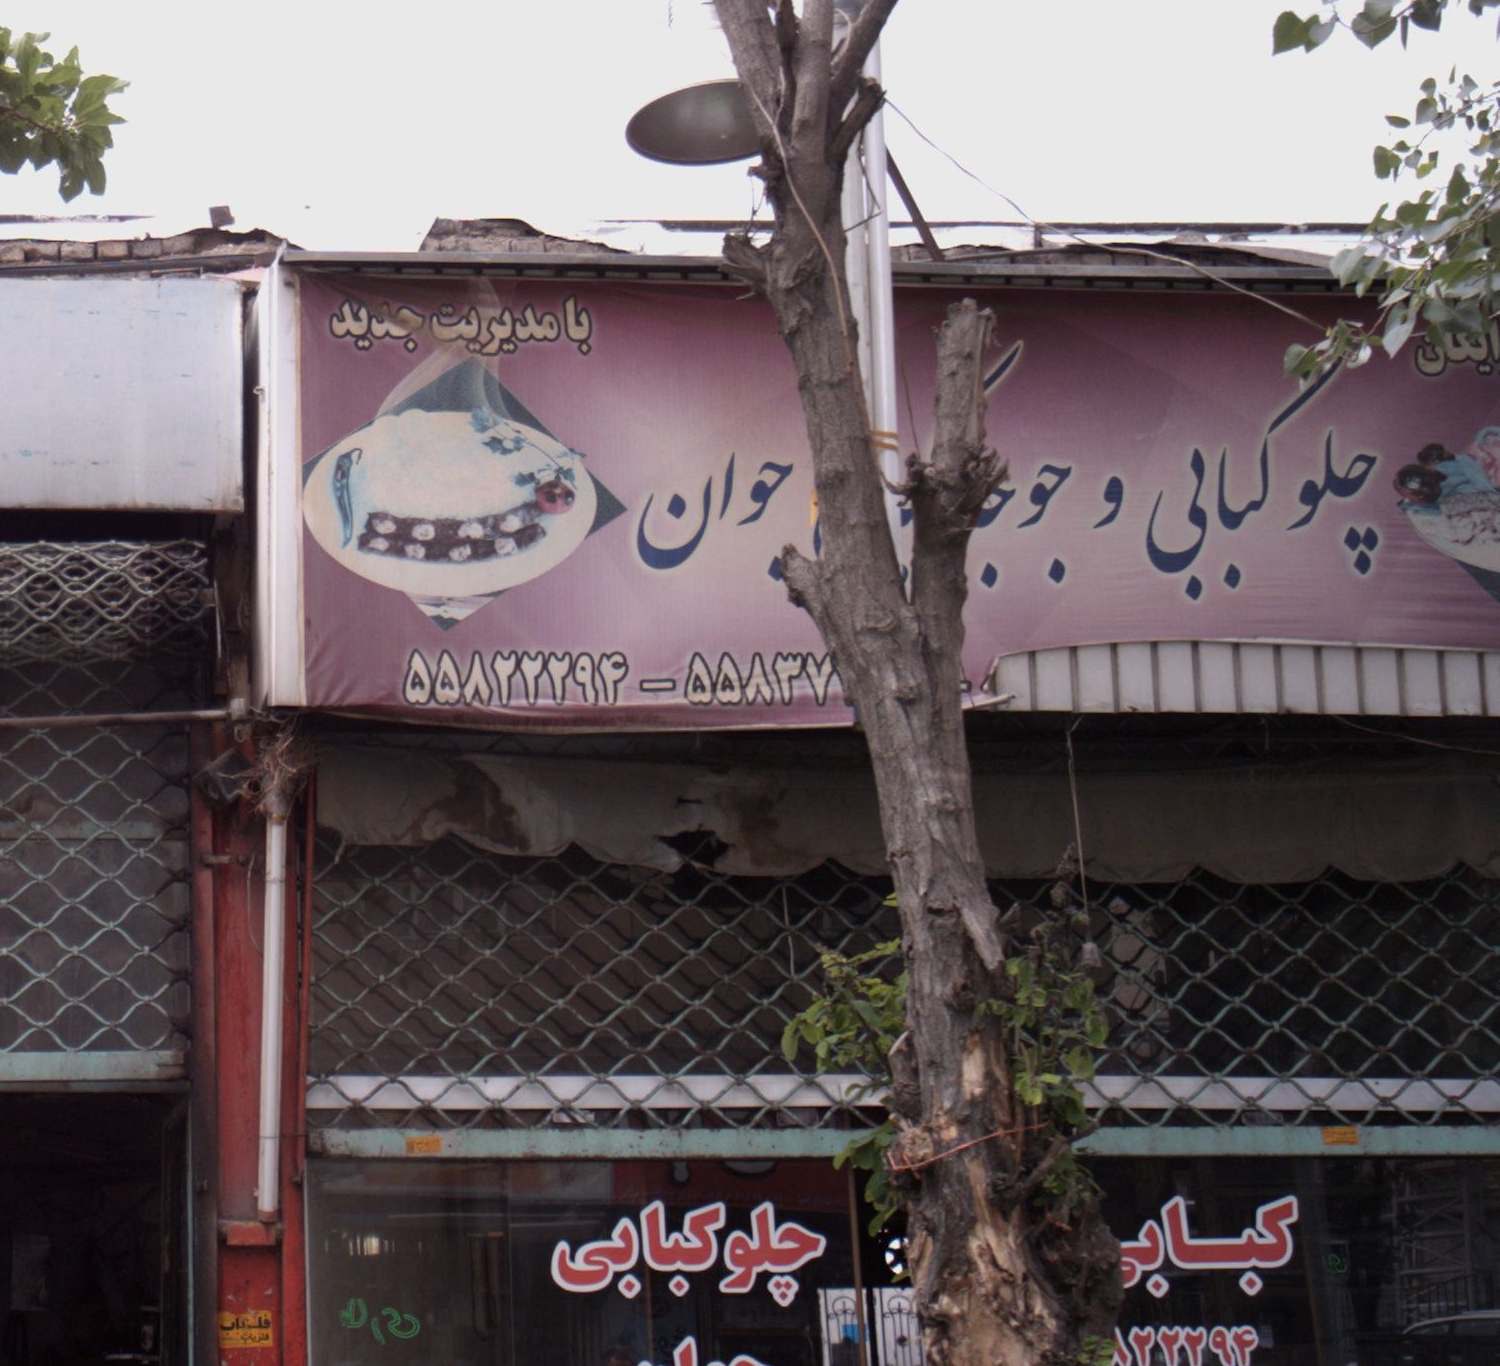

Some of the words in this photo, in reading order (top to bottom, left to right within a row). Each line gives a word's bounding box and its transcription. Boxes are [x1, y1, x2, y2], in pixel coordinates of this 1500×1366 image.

[329, 295, 425, 351] جدید
[430, 301, 561, 355] مدیریت
[563, 295, 593, 355] با
[636, 450, 795, 583] جوان
[1092, 474, 1125, 530] و
[402, 647, 629, 707] ۵۵۸۲۲۲۹۴
[684, 650, 847, 708] ۵۵۸۳۷
